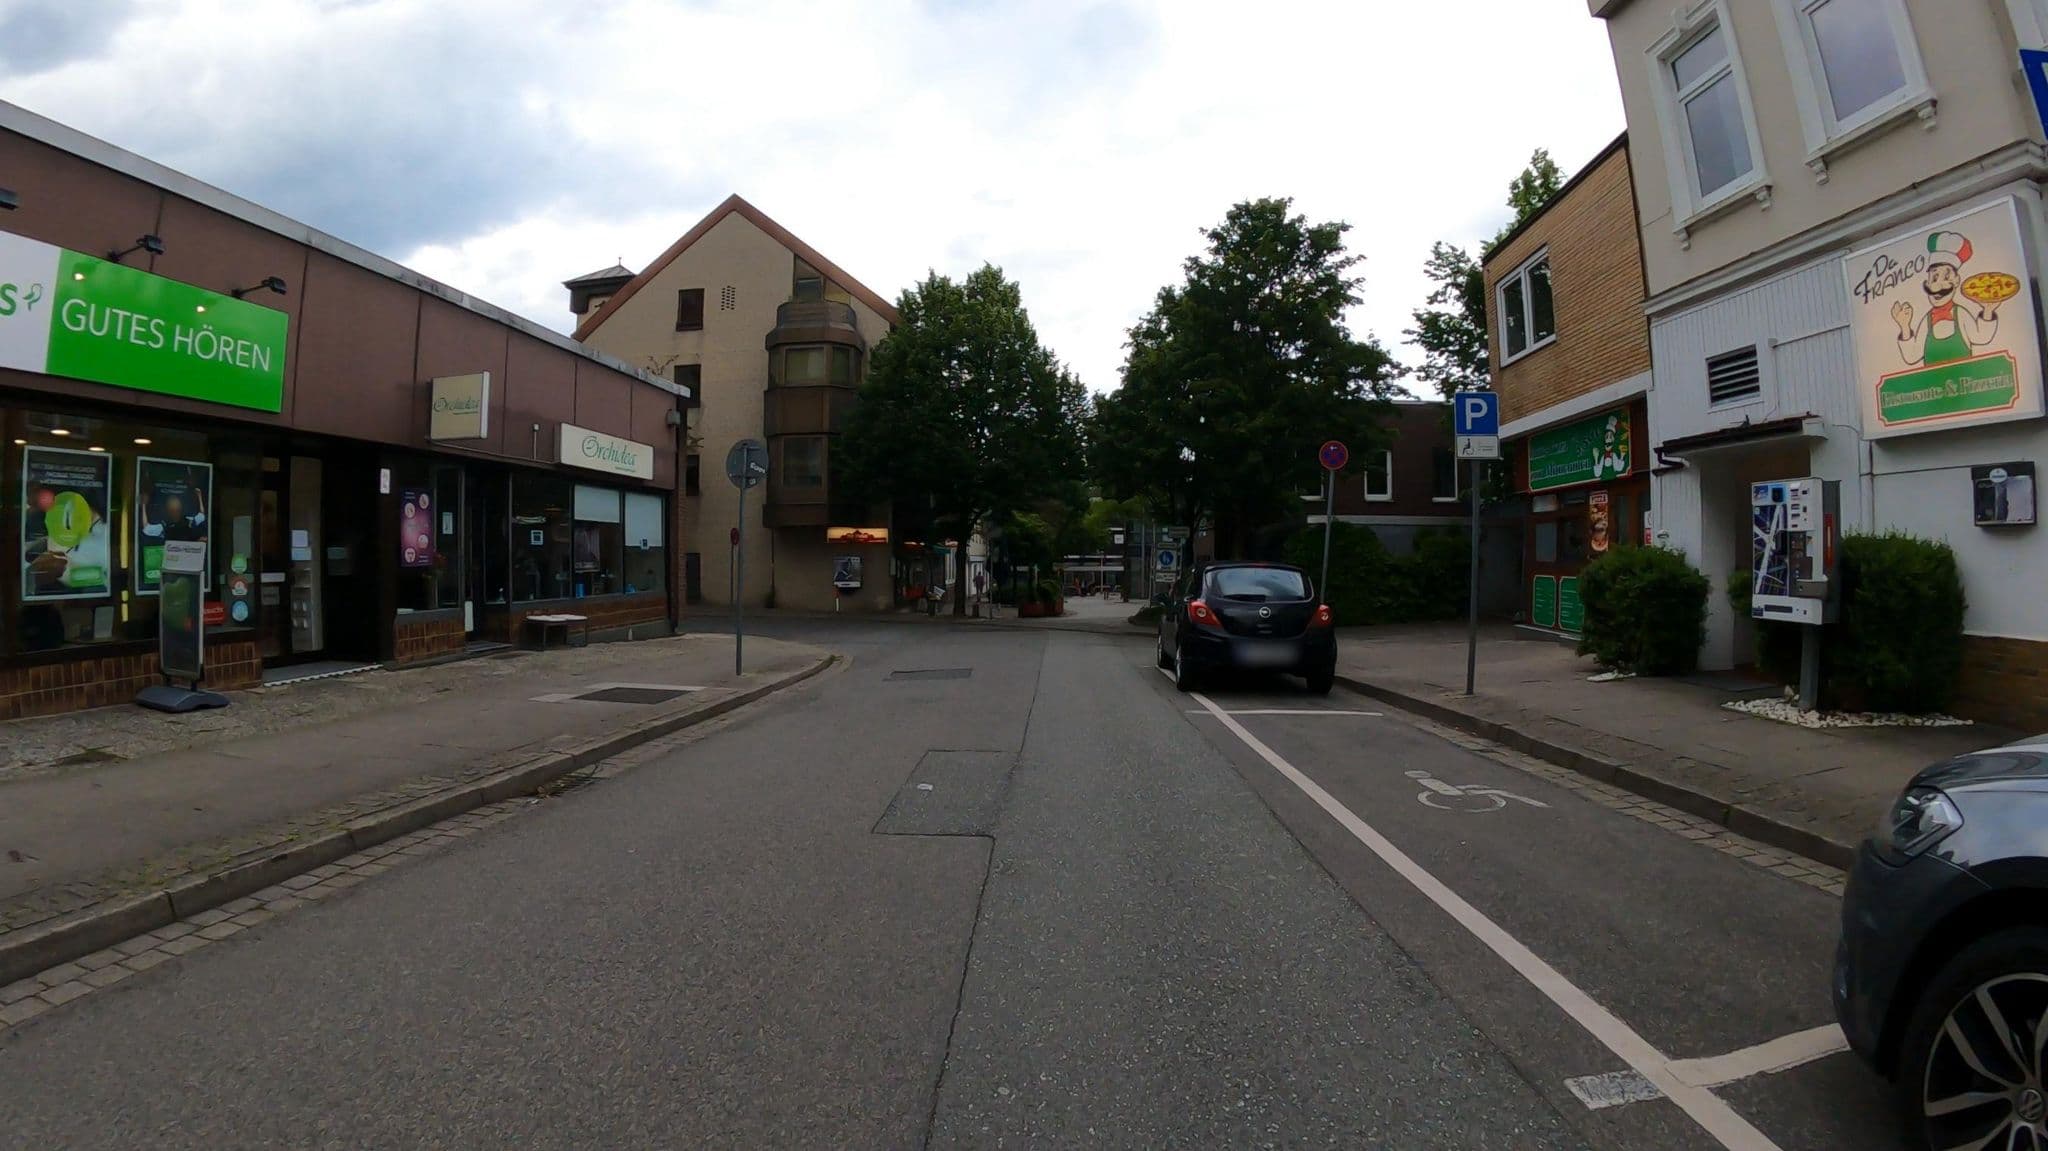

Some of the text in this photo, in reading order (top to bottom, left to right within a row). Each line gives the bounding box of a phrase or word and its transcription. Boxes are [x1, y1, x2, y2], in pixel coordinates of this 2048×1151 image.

[1873, 254, 1899, 278] Da
[61, 298, 271, 373] GUTES HÖREN
[1465, 397, 1489, 431] P
